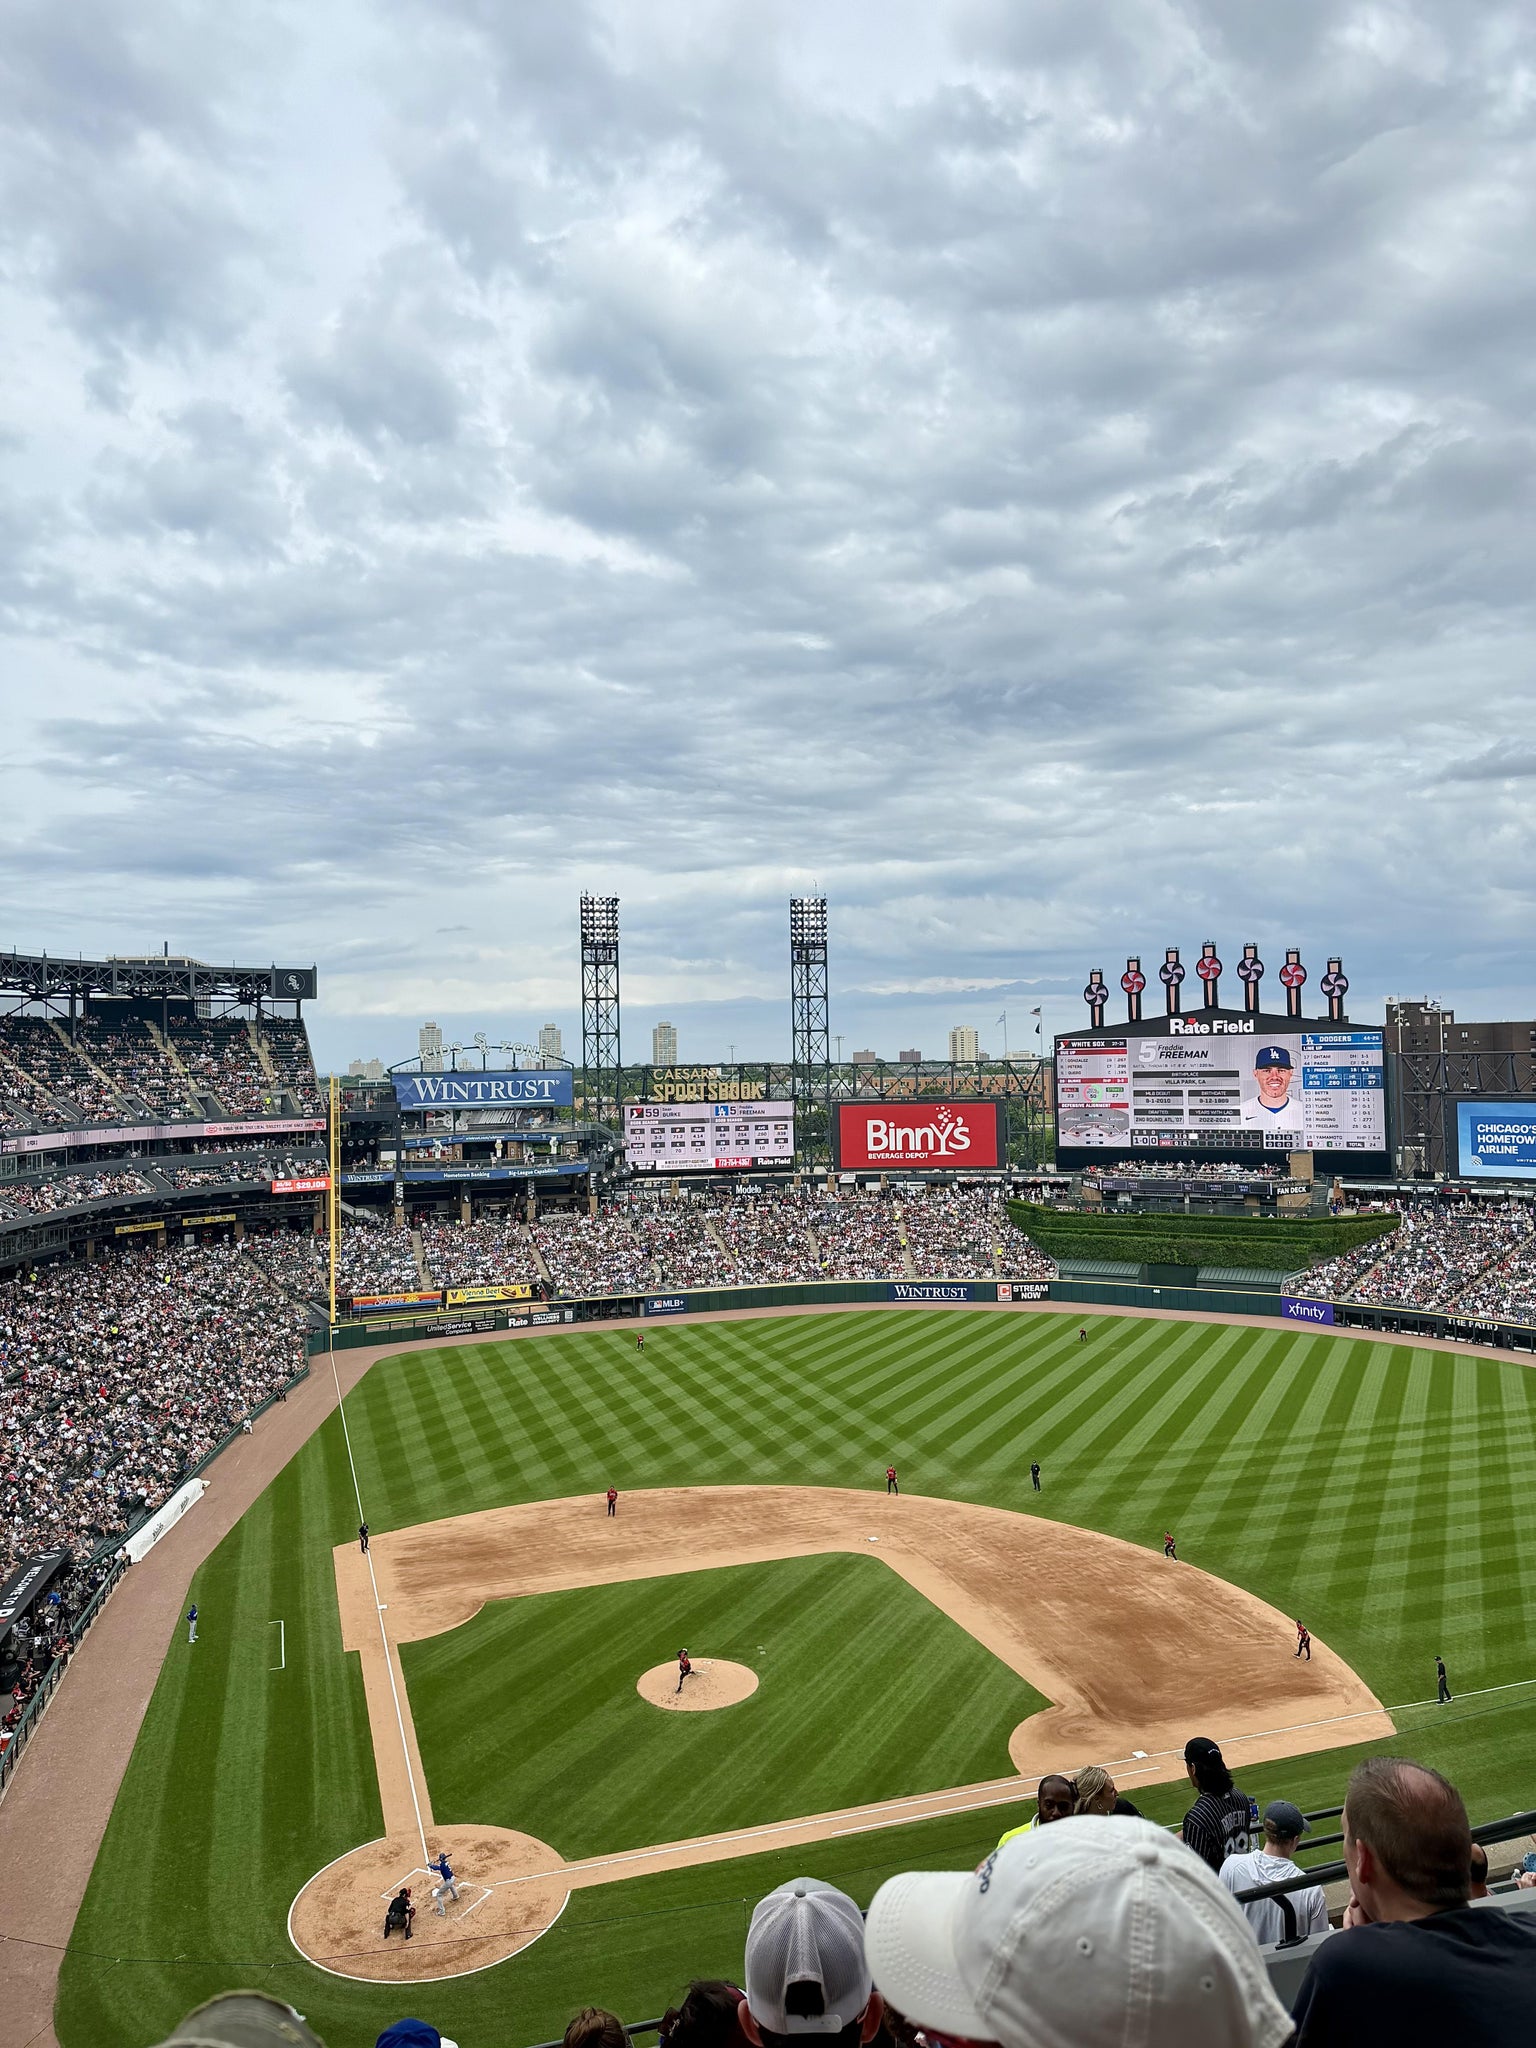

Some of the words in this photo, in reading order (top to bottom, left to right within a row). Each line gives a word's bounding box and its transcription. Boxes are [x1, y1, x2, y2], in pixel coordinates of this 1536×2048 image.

[1169, 1018, 1210, 1034] Rate
[1212, 1019, 1255, 1033] Field
[418, 1041, 464, 1062] KIDS
[499, 1041, 549, 1060] ZONE
[1139, 1041, 1157, 1063] 5
[1159, 1050, 1209, 1059] FREEMAN
[653, 1068, 719, 1080] CAESARS
[411, 1077, 556, 1101] WINTRUST
[653, 1081, 763, 1102] SPORTSBOOK
[645, 1108, 660, 1117] 59
[730, 1106, 737, 1115] 5
[1477, 1123, 1536, 1134] CHICAGO'S
[1477, 1134, 1536, 1145] HOMETOW
[1477, 1144, 1519, 1155] AIRLINE
[868, 1152, 904, 1160] BEVERAGE
[533, 1167, 559, 1175] Capabilities
[735, 1184, 762, 1194] Modelo
[1276, 1187, 1290, 1195] FAN
[1290, 1186, 1307, 1194] DECK
[894, 1285, 968, 1298] WINTRUST
[1012, 1285, 1049, 1293] STREAM
[1020, 1292, 1041, 1300] NOW
[1288, 1302, 1326, 1321] xfinity
[508, 1317, 529, 1328] Rate
[1446, 1317, 1467, 1327] THE
[1468, 1320, 1499, 1331] PATIO
[445, 1327, 473, 1336] Companies
[9, 1565, 44, 1596] WELCOME
[2, 1596, 19, 1606] TO
